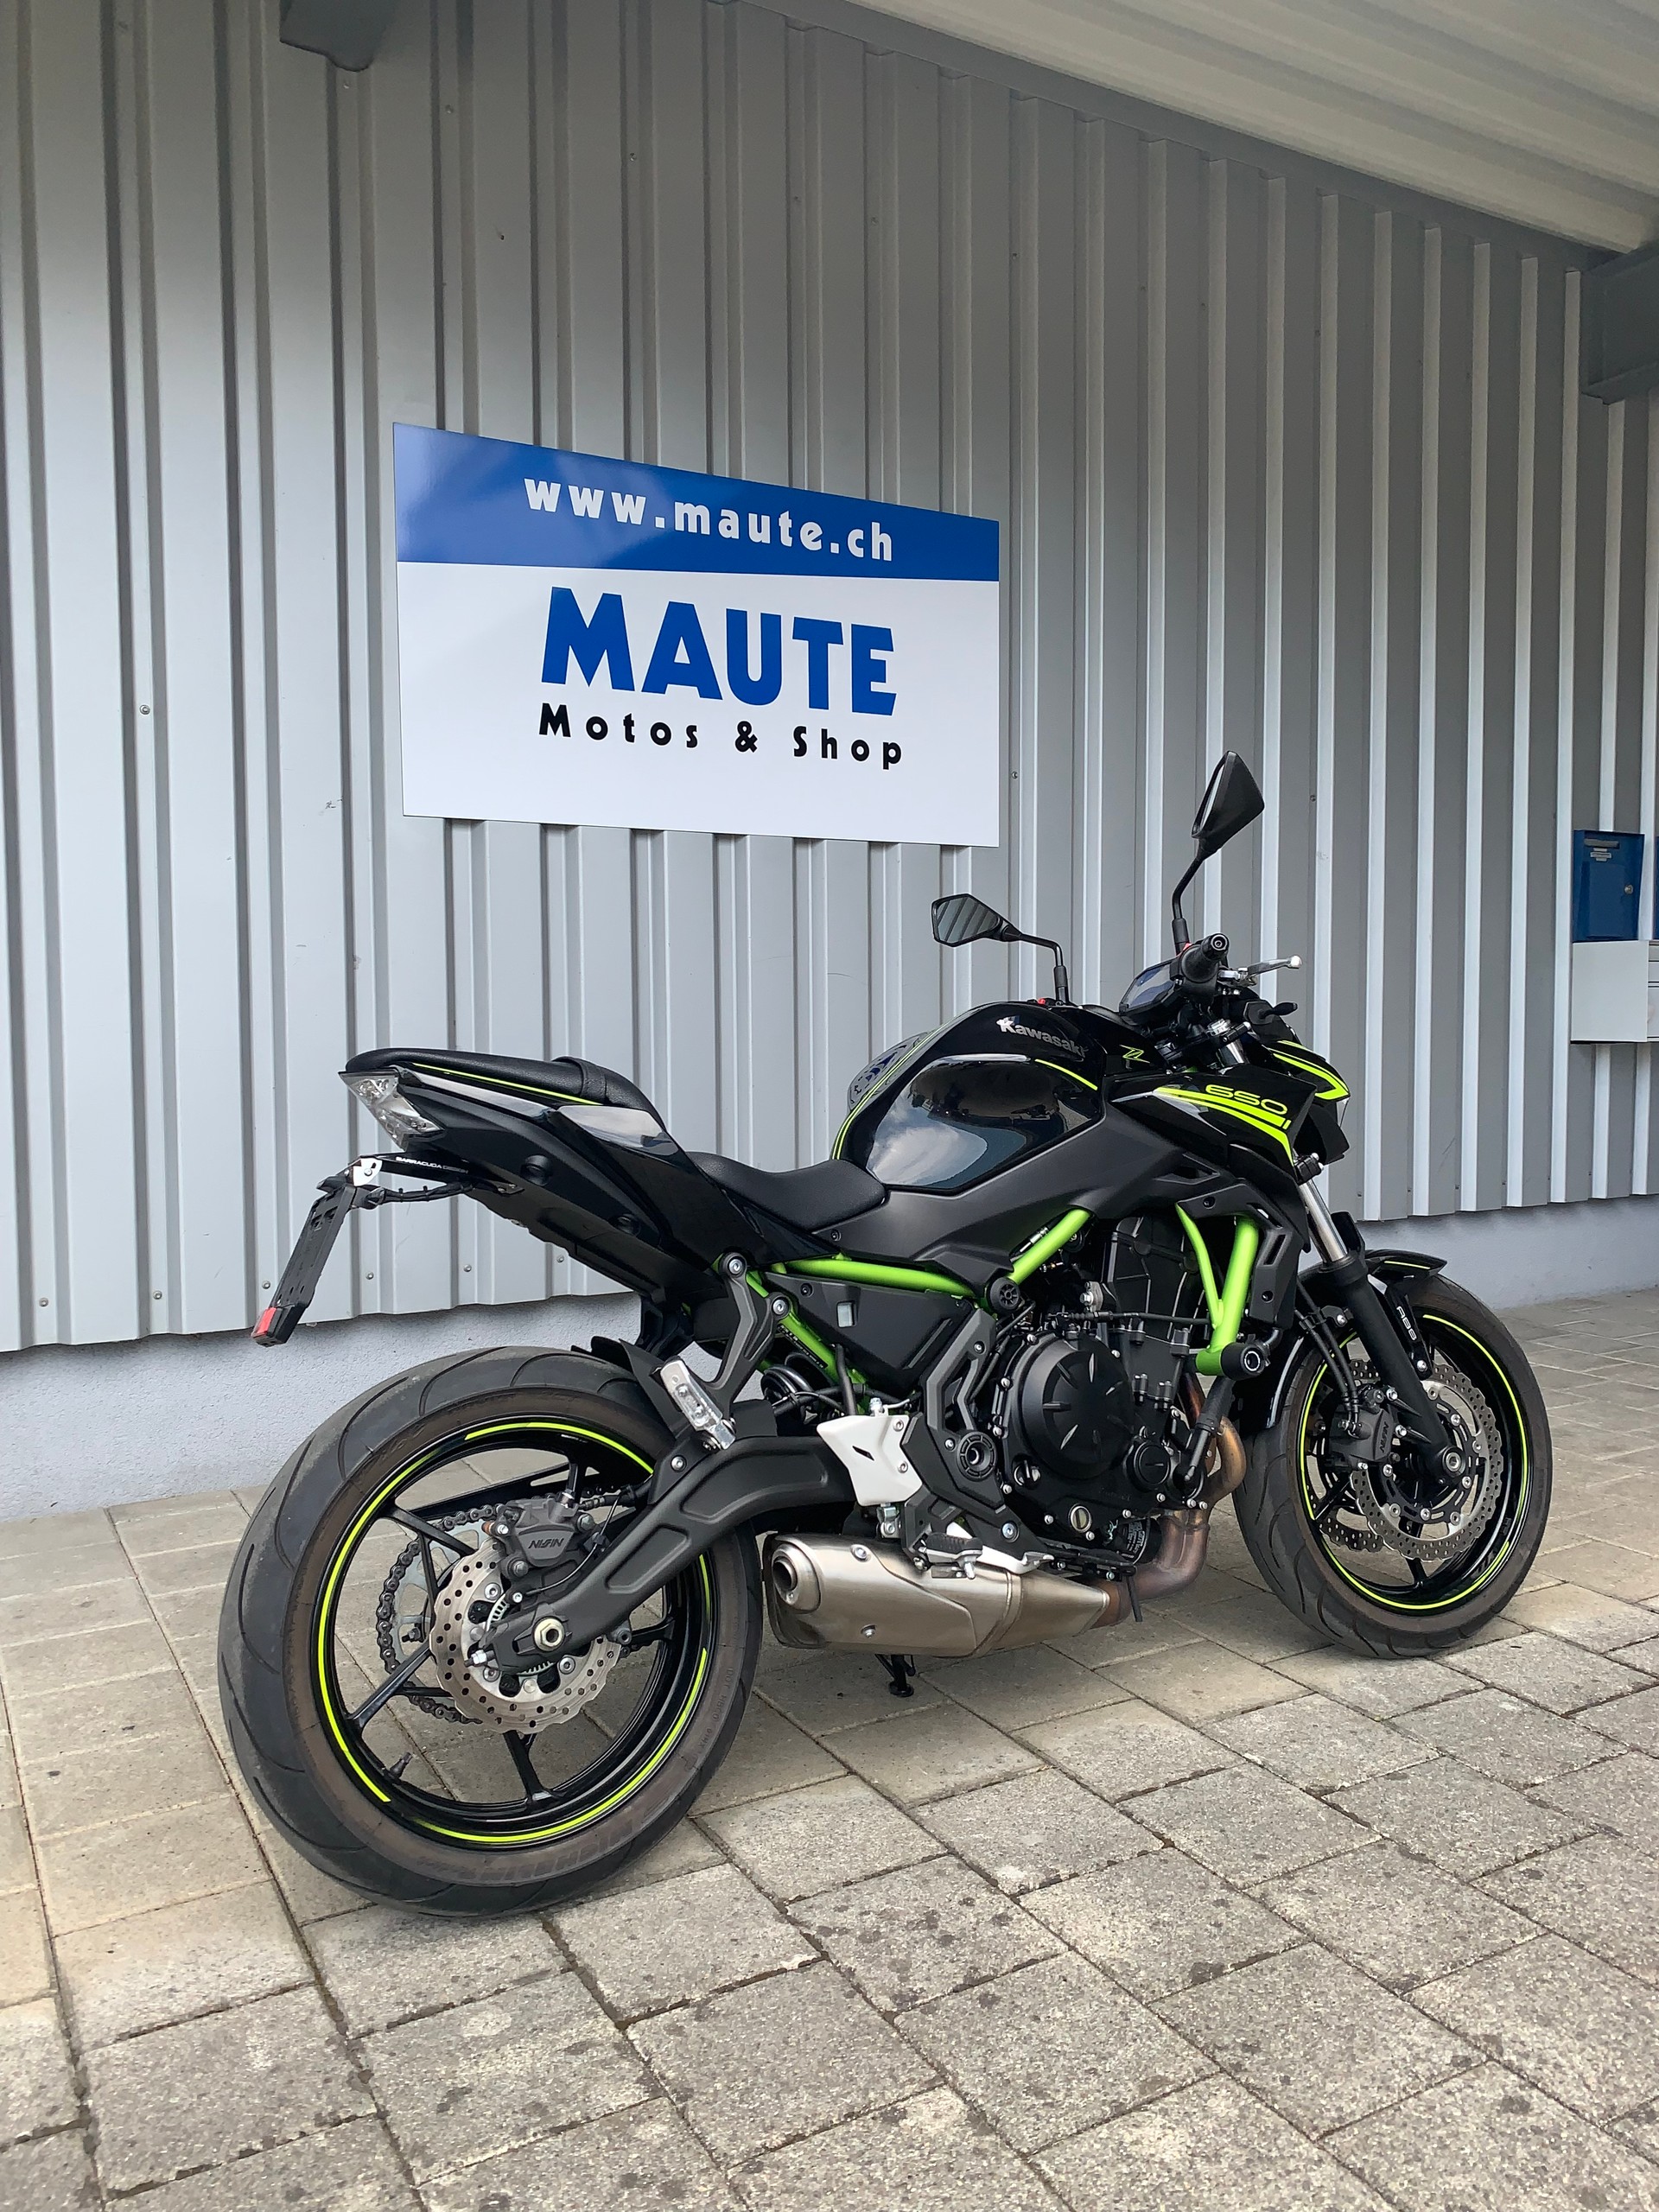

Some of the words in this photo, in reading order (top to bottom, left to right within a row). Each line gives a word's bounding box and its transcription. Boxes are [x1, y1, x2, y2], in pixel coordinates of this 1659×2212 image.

[524, 477, 893, 563] www.maute.ch
[541, 586, 897, 715] MAUTE
[538, 702, 698, 748] Motos
[734, 721, 758, 753] &
[793, 725, 902, 770] Shop
[996, 1016, 1089, 1058] Kawasaki
[1205, 1084, 1288, 1116] 650
